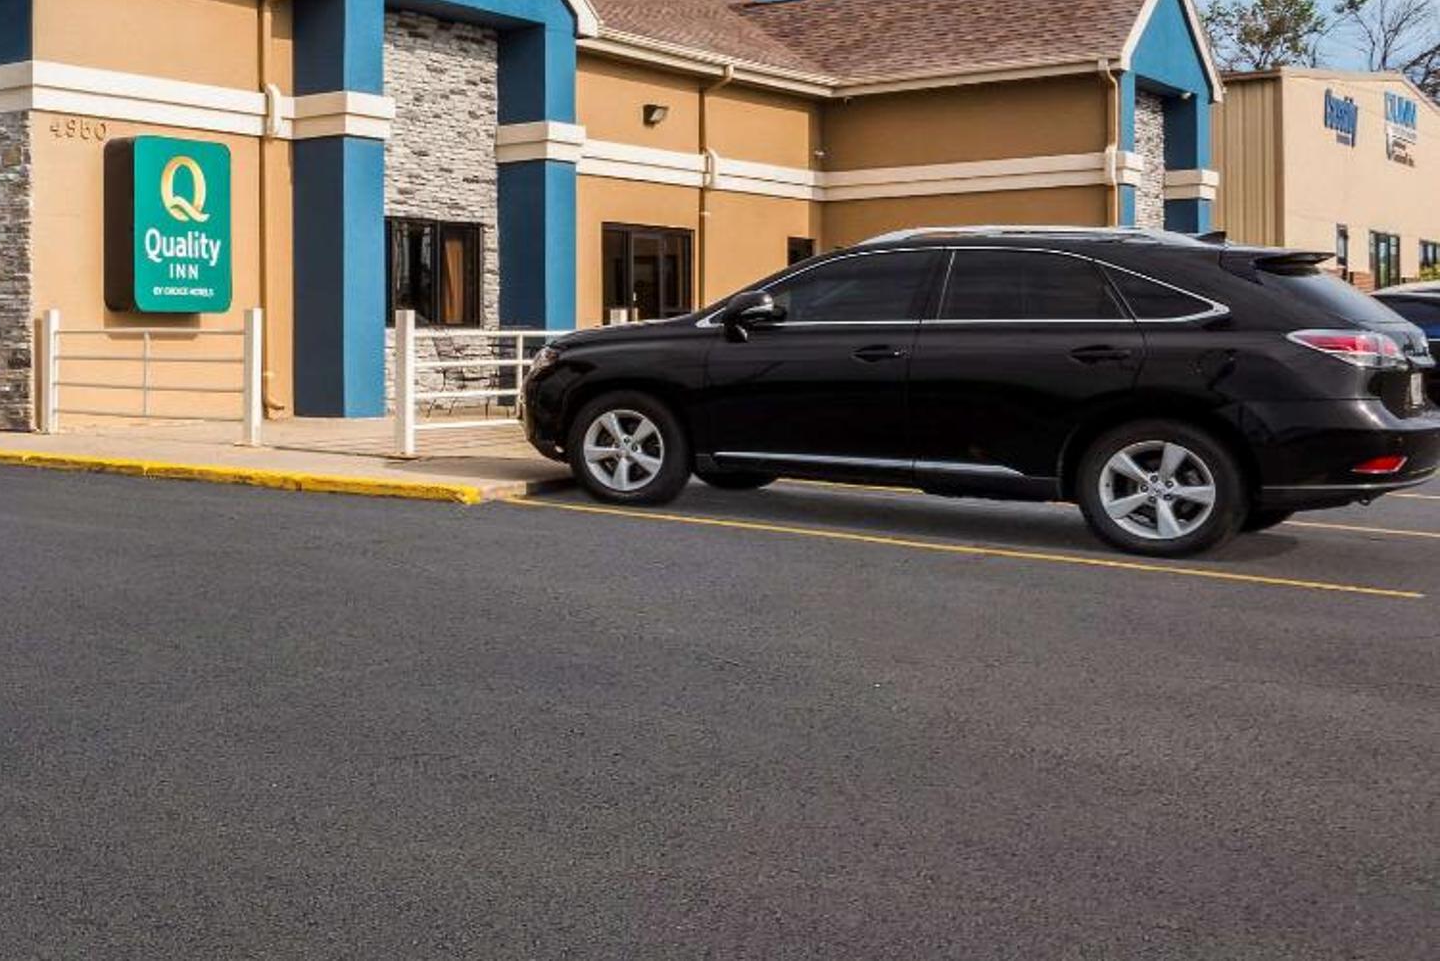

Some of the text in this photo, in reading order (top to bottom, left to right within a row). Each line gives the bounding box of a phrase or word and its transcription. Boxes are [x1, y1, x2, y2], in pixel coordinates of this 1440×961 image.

[161, 155, 210, 222] Q
[144, 227, 221, 266] Quality
[169, 263, 200, 280] INN
